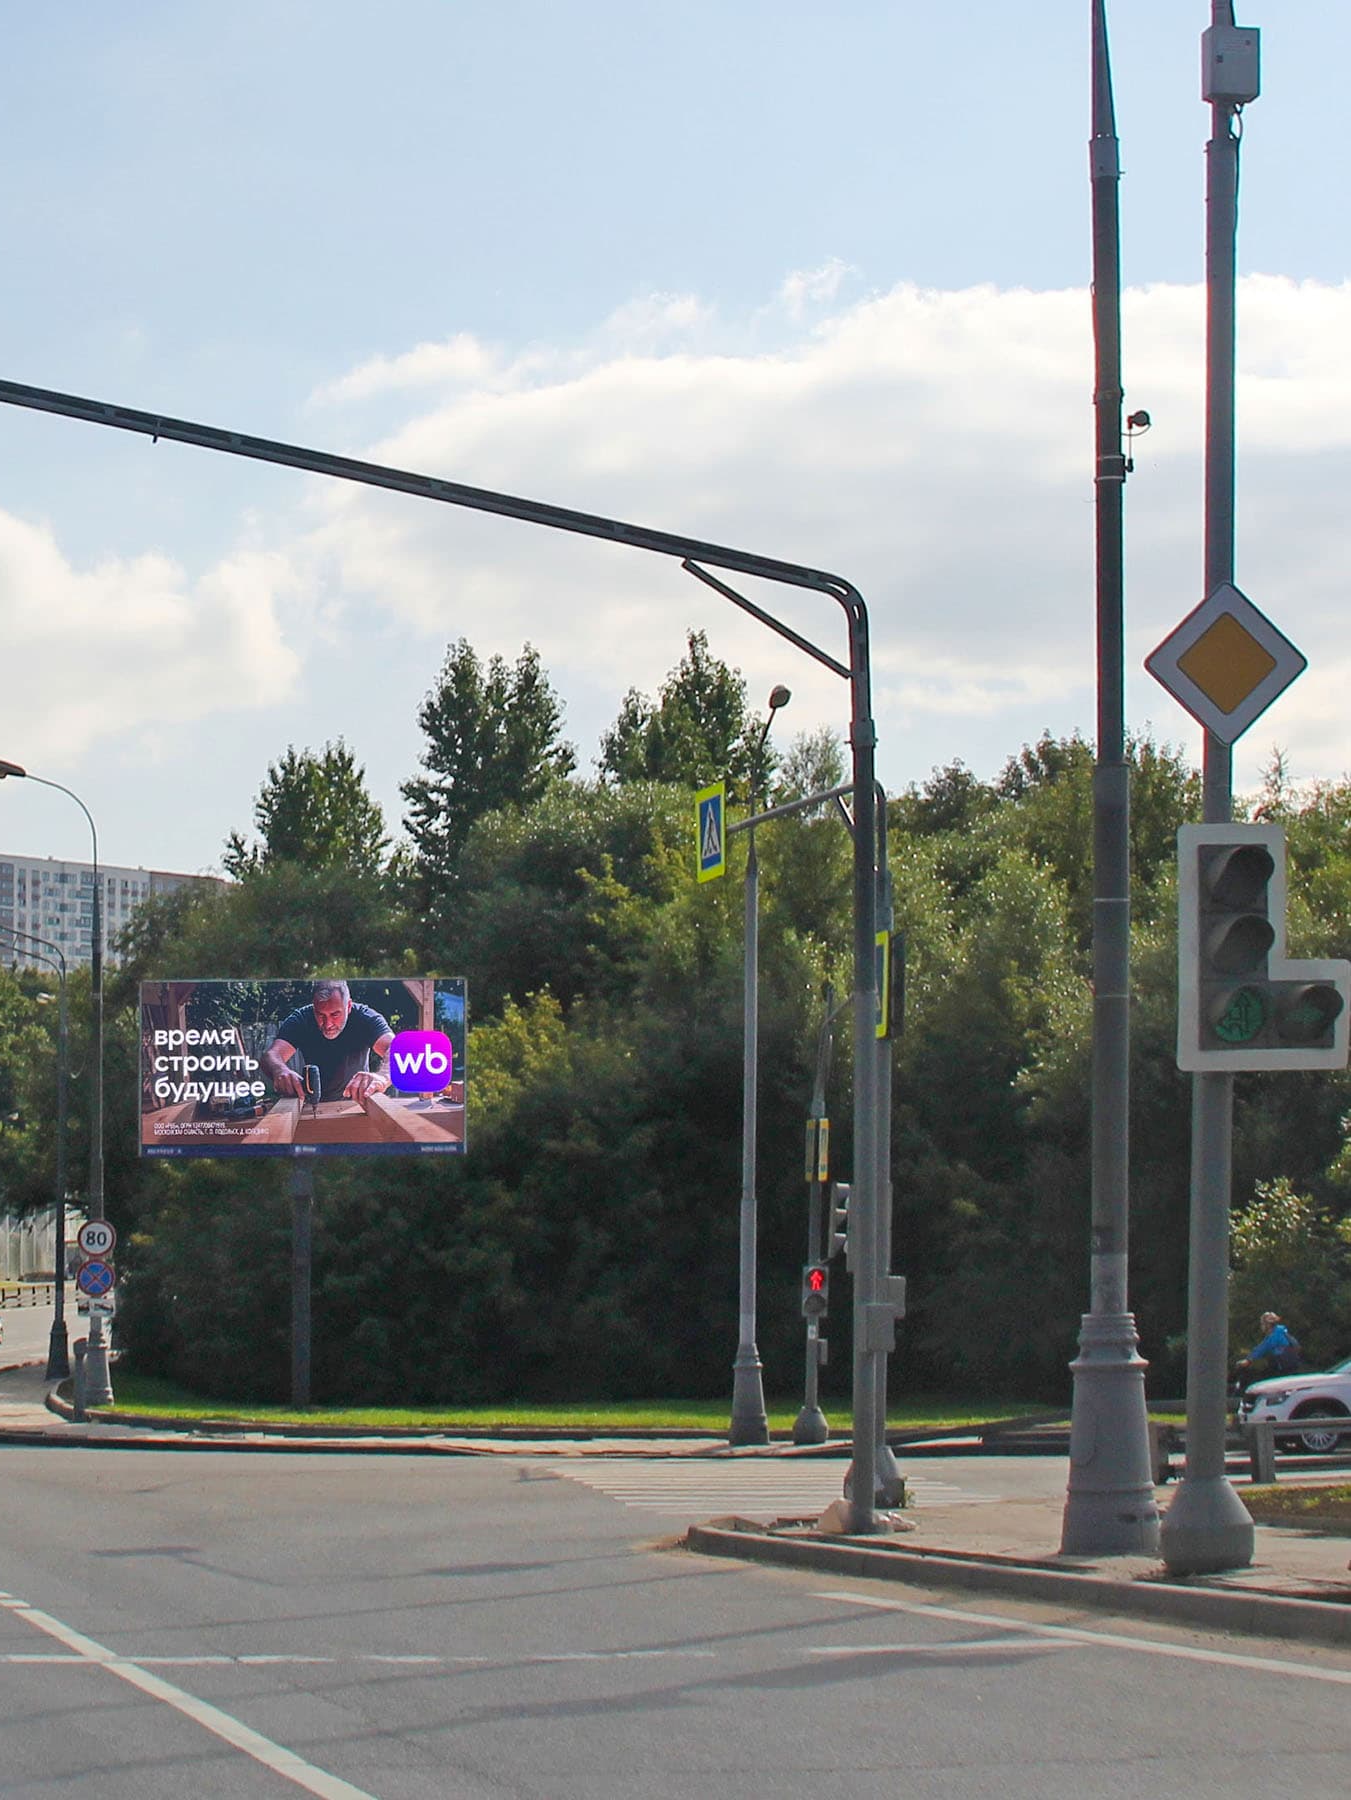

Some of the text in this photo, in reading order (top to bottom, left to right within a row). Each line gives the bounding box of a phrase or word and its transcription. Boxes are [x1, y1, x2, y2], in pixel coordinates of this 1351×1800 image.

[155, 1029, 236, 1050] время
[155, 1055, 259, 1076] строить
[394, 1044, 448, 1074] wb
[155, 1076, 266, 1103] будущее
[86, 1231, 107, 1246] 80
